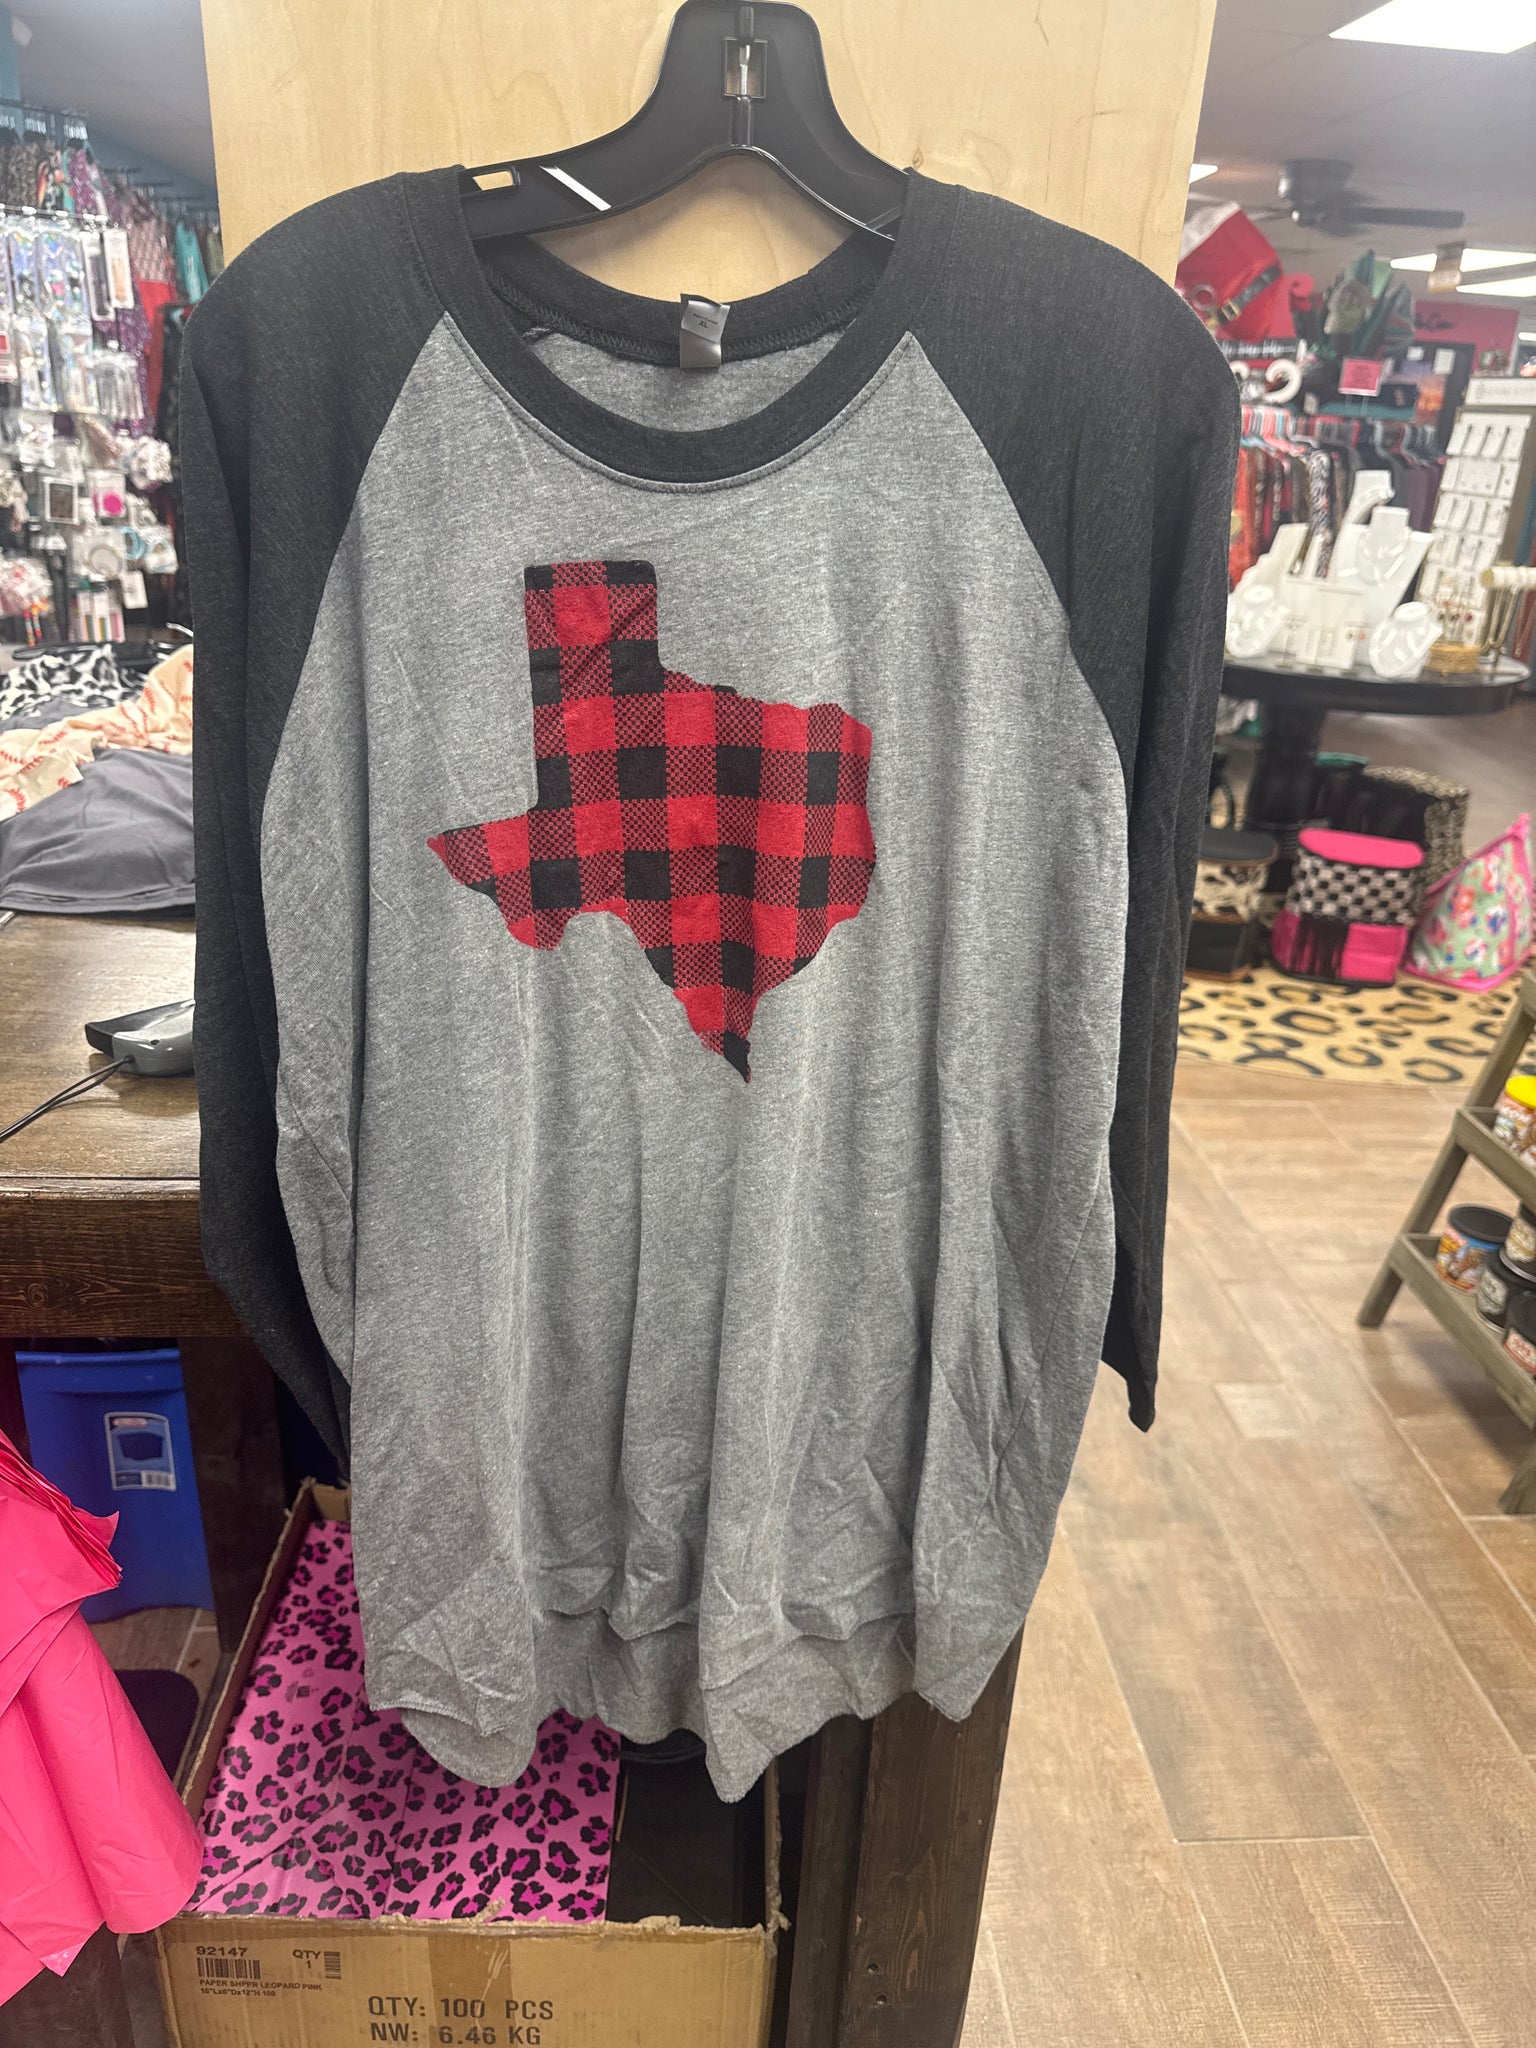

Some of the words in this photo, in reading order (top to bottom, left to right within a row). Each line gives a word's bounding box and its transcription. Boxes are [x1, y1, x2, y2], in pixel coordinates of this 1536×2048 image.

[196, 1946, 248, 1957] 92147
[292, 1949, 321, 1960] QTY
[305, 1960, 312, 1969] 1
[199, 1979, 228, 1987] PAPER
[230, 1980, 258, 1988] SHPPR
[260, 1981, 300, 1990] LEOPARD
[302, 1983, 322, 1991] PINK
[263, 1989, 276, 1997] 100
[368, 1996, 426, 2017] QTY:
[440, 1998, 485, 2019] 100
[505, 1999, 554, 2020] PCS
[370, 2022, 419, 2042] NW:
[438, 2025, 497, 2045] 6.46
[508, 2025, 541, 2045] KG
